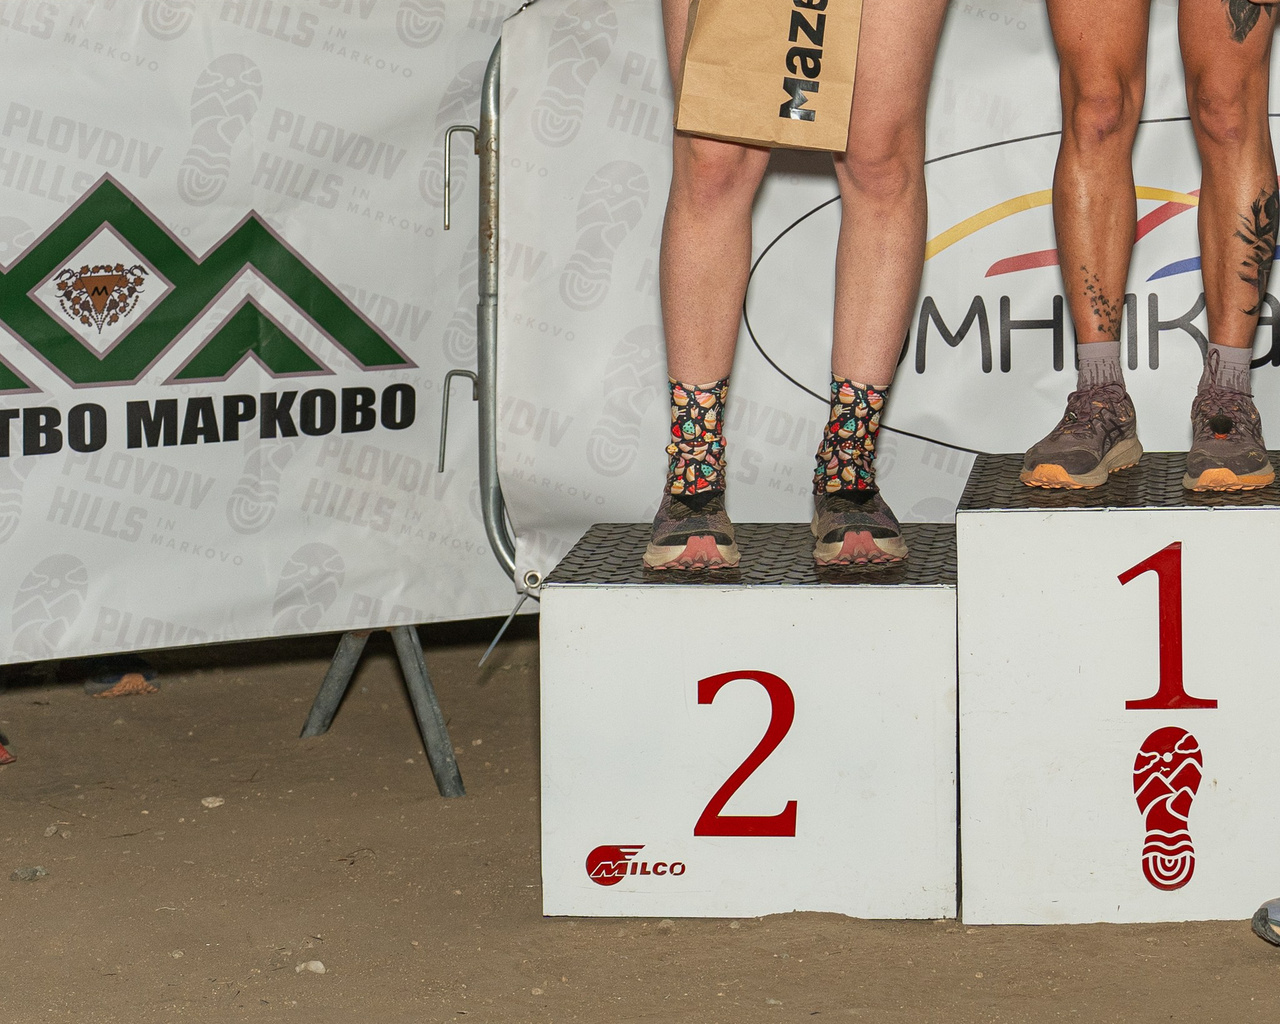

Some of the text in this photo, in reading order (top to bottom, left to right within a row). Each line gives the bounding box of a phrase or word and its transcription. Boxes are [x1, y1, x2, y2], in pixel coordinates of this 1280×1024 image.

[63, 32, 160, 72] MARKOVO
[327, 25, 348, 40] IN
[321, 40, 414, 80] MARKOVO
[1, 101, 163, 179] PLOVDIV
[266, 107, 407, 182] PLOVDIV
[251, 151, 344, 210] HILLS
[351, 186, 371, 200] IN
[346, 201, 435, 239] MARKOVO
[125, 382, 417, 450] МАРКОВО
[315, 433, 455, 502] PLOVDIV
[516, 451, 536, 468] IN
[301, 477, 397, 533] HILLS
[511, 467, 606, 507] MARKOVO
[46, 485, 148, 543] HILLS
[156, 517, 176, 531] IN
[404, 510, 423, 523] IN
[150, 532, 244, 566] MARKOVO
[400, 523, 488, 557] MARKOVO
[1117, 541, 1218, 710] 1
[693, 670, 798, 837] 2
[590, 860, 686, 878] MILCO
